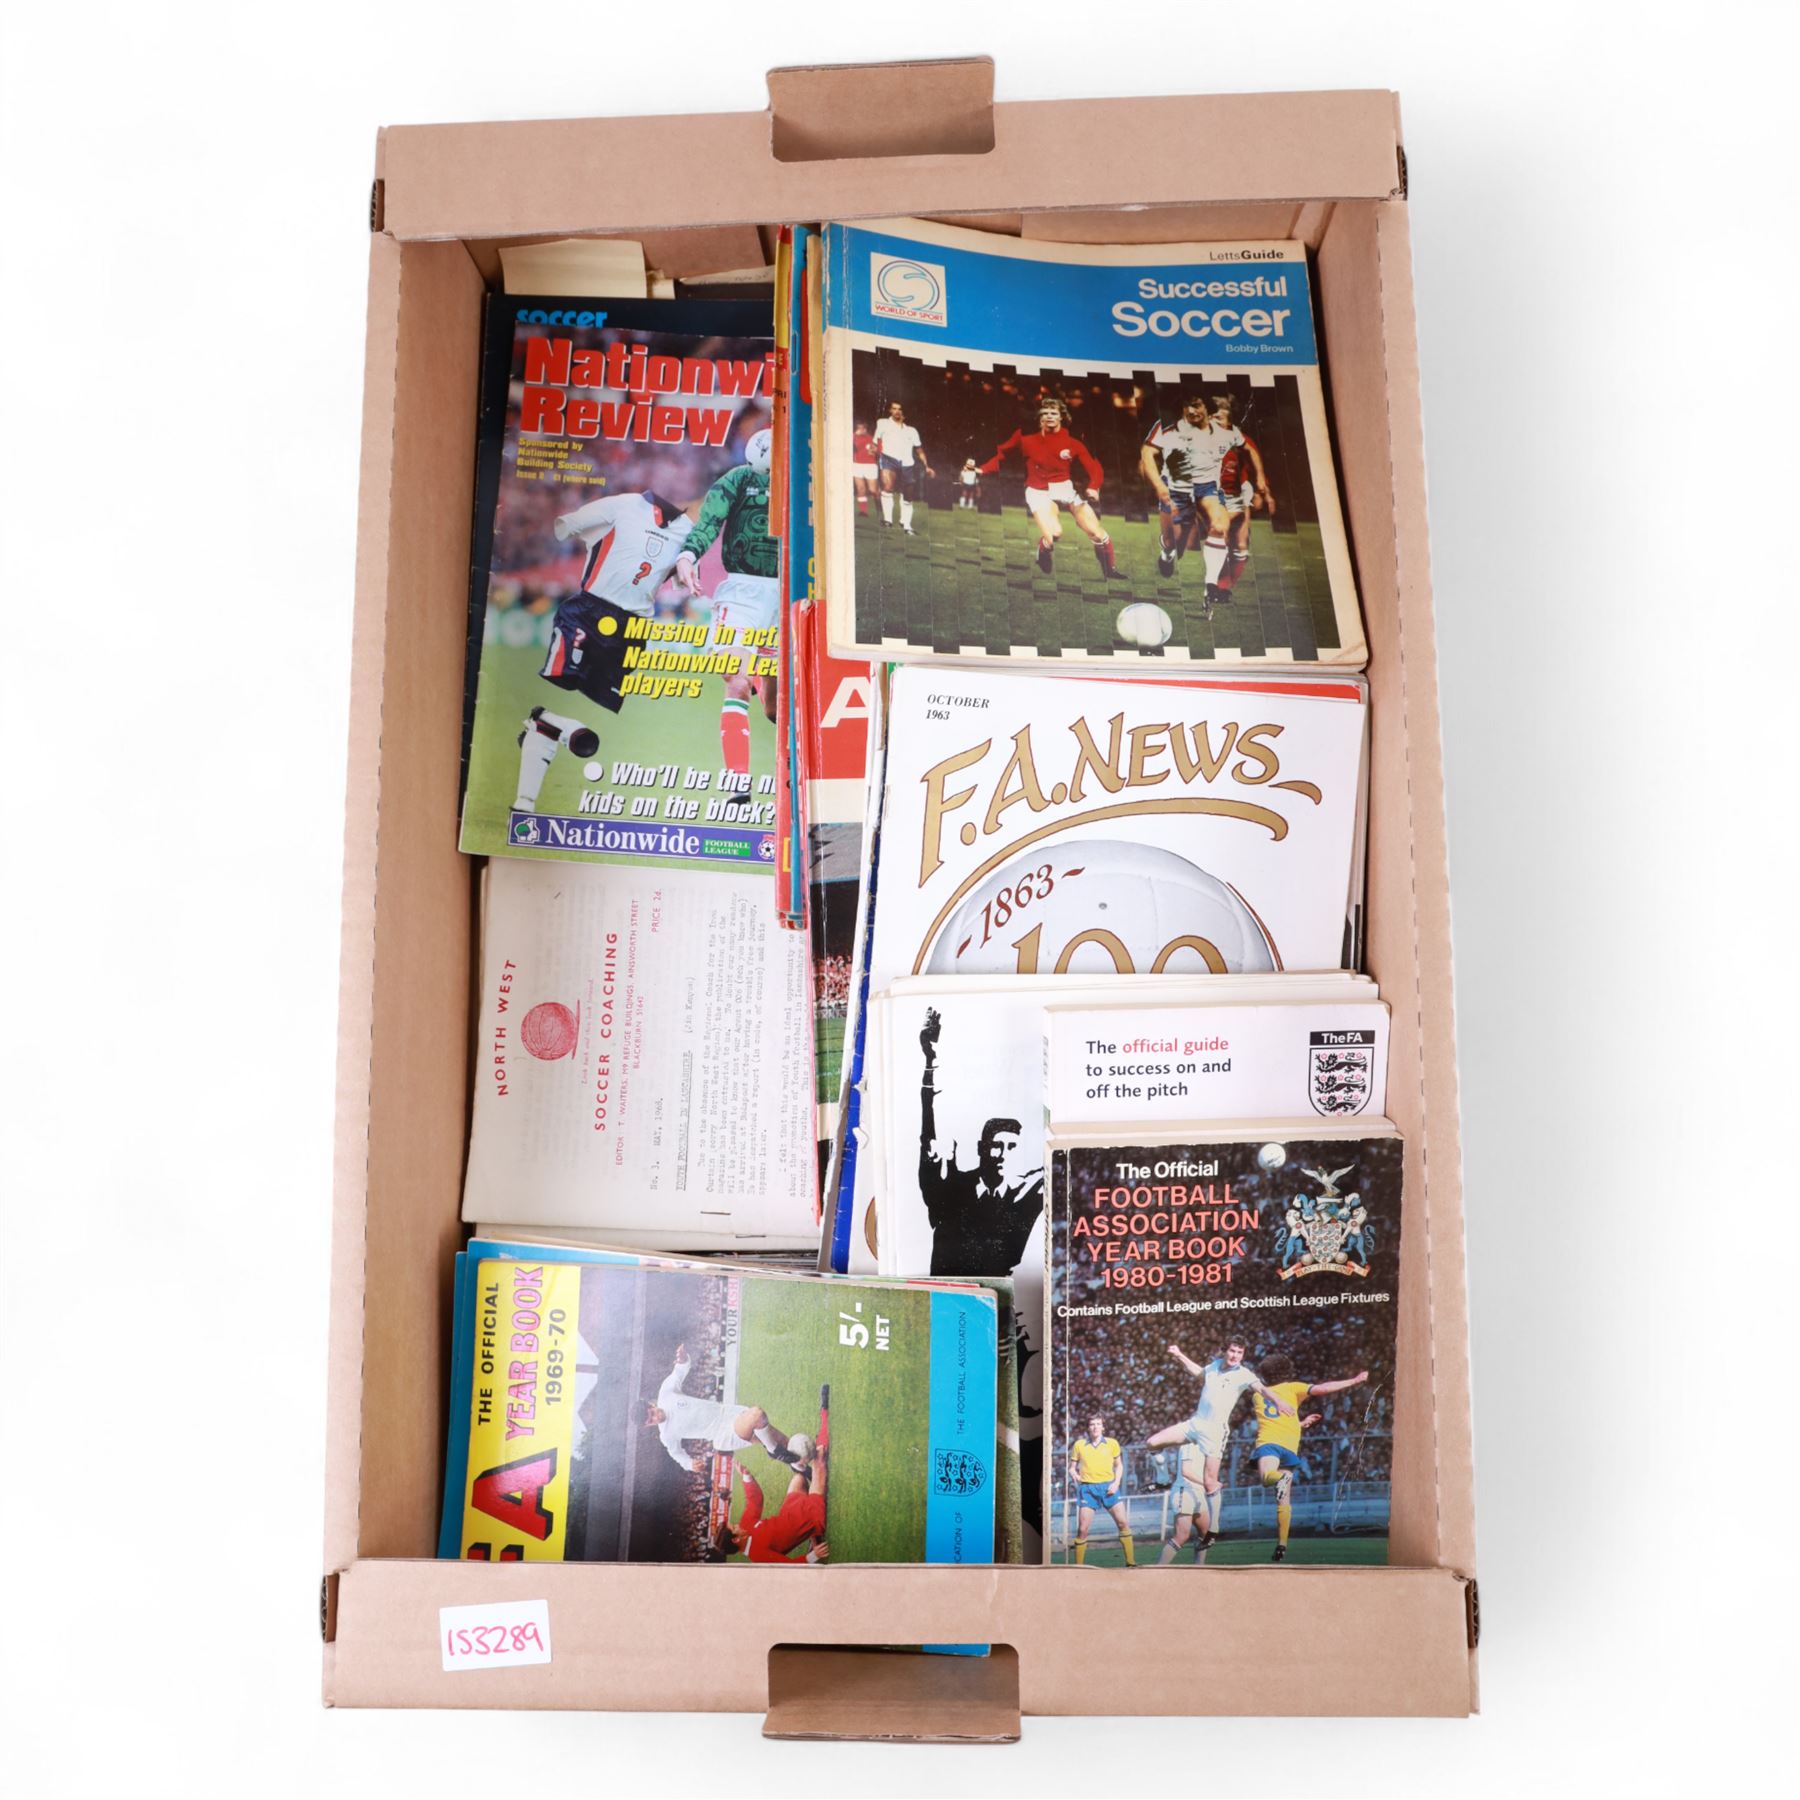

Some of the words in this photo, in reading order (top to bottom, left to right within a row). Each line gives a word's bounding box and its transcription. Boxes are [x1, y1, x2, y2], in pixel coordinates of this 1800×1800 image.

[1138, 276, 1288, 299] Successful
[875, 303, 906, 315] WORLD
[906, 309, 917, 317] OF
[920, 311, 943, 321] SPORT
[1111, 301, 1292, 338] Soccer
[1226, 344, 1259, 354] Bobby
[1260, 344, 1294, 353] Brown
[520, 386, 735, 447] Review
[517, 447, 569, 459] Nationwide
[518, 438, 569, 450] Sponsored
[572, 441, 584, 452] by
[516, 458, 554, 470] Building
[557, 461, 593, 473] Society
[623, 616, 709, 648] Missing
[713, 623, 738, 646] in
[742, 625, 778, 649] act
[622, 646, 742, 674] Nationwide
[618, 672, 704, 700] players
[926, 708, 951, 721] 1963
[927, 693, 990, 709] OCTOBER
[610, 761, 679, 788] Who'll
[683, 766, 710, 791] be
[715, 768, 752, 794] the
[578, 789, 625, 816] kids
[630, 796, 656, 818] on
[663, 793, 700, 821] the
[704, 796, 775, 825] block?
[545, 819, 700, 855] Nationwide
[704, 839, 751, 849] FOOTBALL
[704, 846, 740, 856] LEAGUE
[651, 907, 661, 933] PRICE
[628, 930, 637, 978] AINSWORTH
[497, 960, 516, 1013] WEST
[601, 933, 617, 1038] COACHING
[634, 1021, 642, 1069] BLACKBURN
[1086, 1040, 1117, 1055] The
[1122, 1038, 1179, 1054] official
[1183, 1037, 1230, 1056] guide
[495, 1027, 508, 1096] NORTH
[1086, 1063, 1103, 1077] to
[1108, 1063, 1171, 1077] success
[1176, 1062, 1197, 1074] on
[1201, 1058, 1232, 1073] and
[594, 1054, 610, 1131] SOCCER
[1086, 1083, 1110, 1099] off
[1114, 1083, 1142, 1098] the
[1147, 1081, 1188, 1101] pitch
[1116, 1163, 1151, 1180] The
[1154, 1160, 1219, 1178] Official
[1094, 1184, 1240, 1209] FOOTBALL
[1073, 1209, 1260, 1237] ASSOCIATION
[1086, 1240, 1160, 1263] YEAR
[1168, 1236, 1247, 1260] BOOK
[1100, 1263, 1234, 1289] 1980-1981
[510, 1266, 543, 1352] BOOK
[1057, 1303, 1113, 1318] Contains
[1115, 1301, 1164, 1315] Football
[1166, 1301, 1212, 1314] League
[1214, 1298, 1239, 1311] and
[1240, 1296, 1291, 1309] Scottish
[1292, 1295, 1339, 1308] League
[1340, 1292, 1390, 1305] Fixtures
[481, 1283, 498, 1374] OFFICIAL
[875, 1314, 890, 1351] NET
[957, 1311, 967, 1368] ASSOCIATION
[545, 1309, 566, 1405] 1969-70
[478, 1388, 492, 1425] THE
[506, 1360, 538, 1441] YEAR
[956, 1372, 966, 1414] FOOTBALL
[956, 1418, 965, 1435] THE
[467, 1447, 557, 1563] A
[953, 1511, 963, 1524] OF
